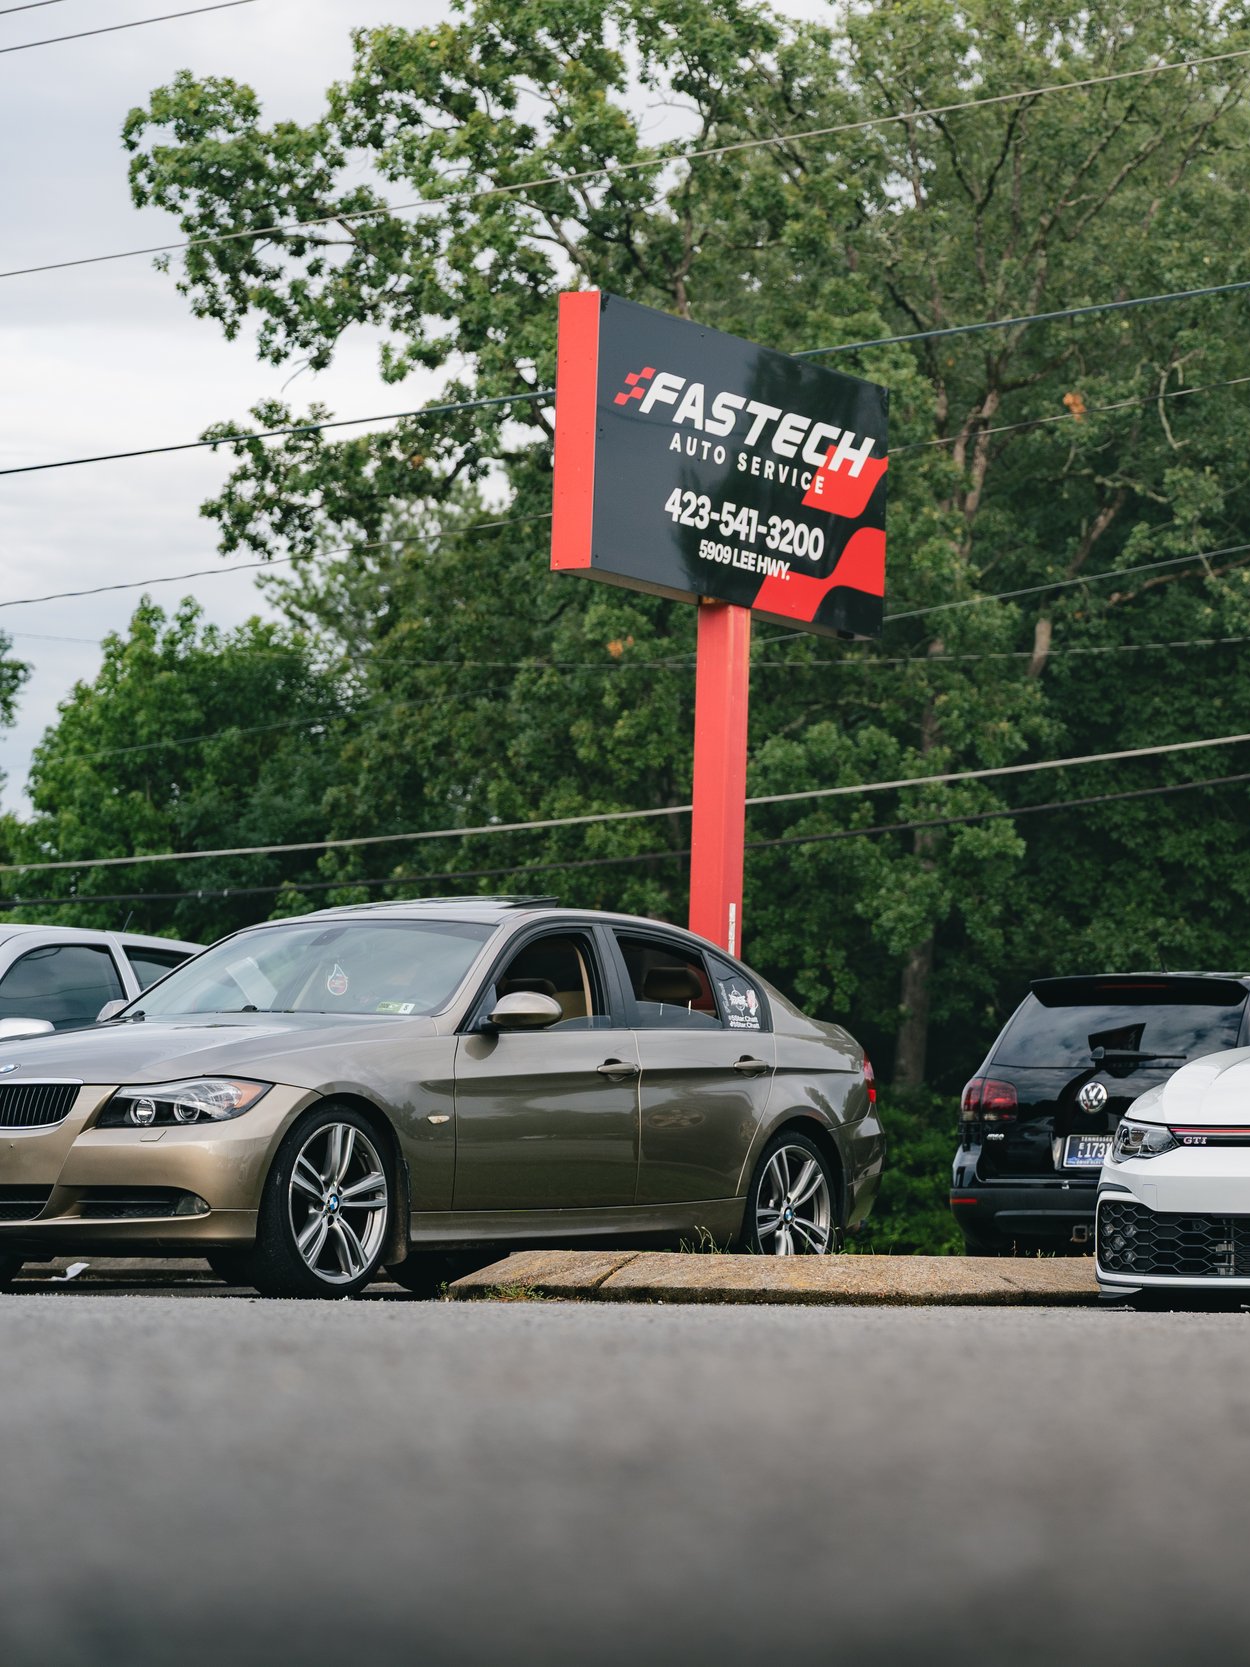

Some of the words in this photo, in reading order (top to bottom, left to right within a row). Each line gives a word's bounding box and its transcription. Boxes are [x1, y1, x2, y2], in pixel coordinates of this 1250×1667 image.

[638, 372, 876, 478] FASTECH
[669, 433, 727, 465] AUTO
[737, 452, 825, 494] SERVICE
[664, 487, 825, 561] 423-541-3200
[699, 539, 732, 564] 5909
[732, 547, 757, 572] LEE
[756, 554, 790, 581] HWY.
[1183, 1136, 1208, 1145] GTI
